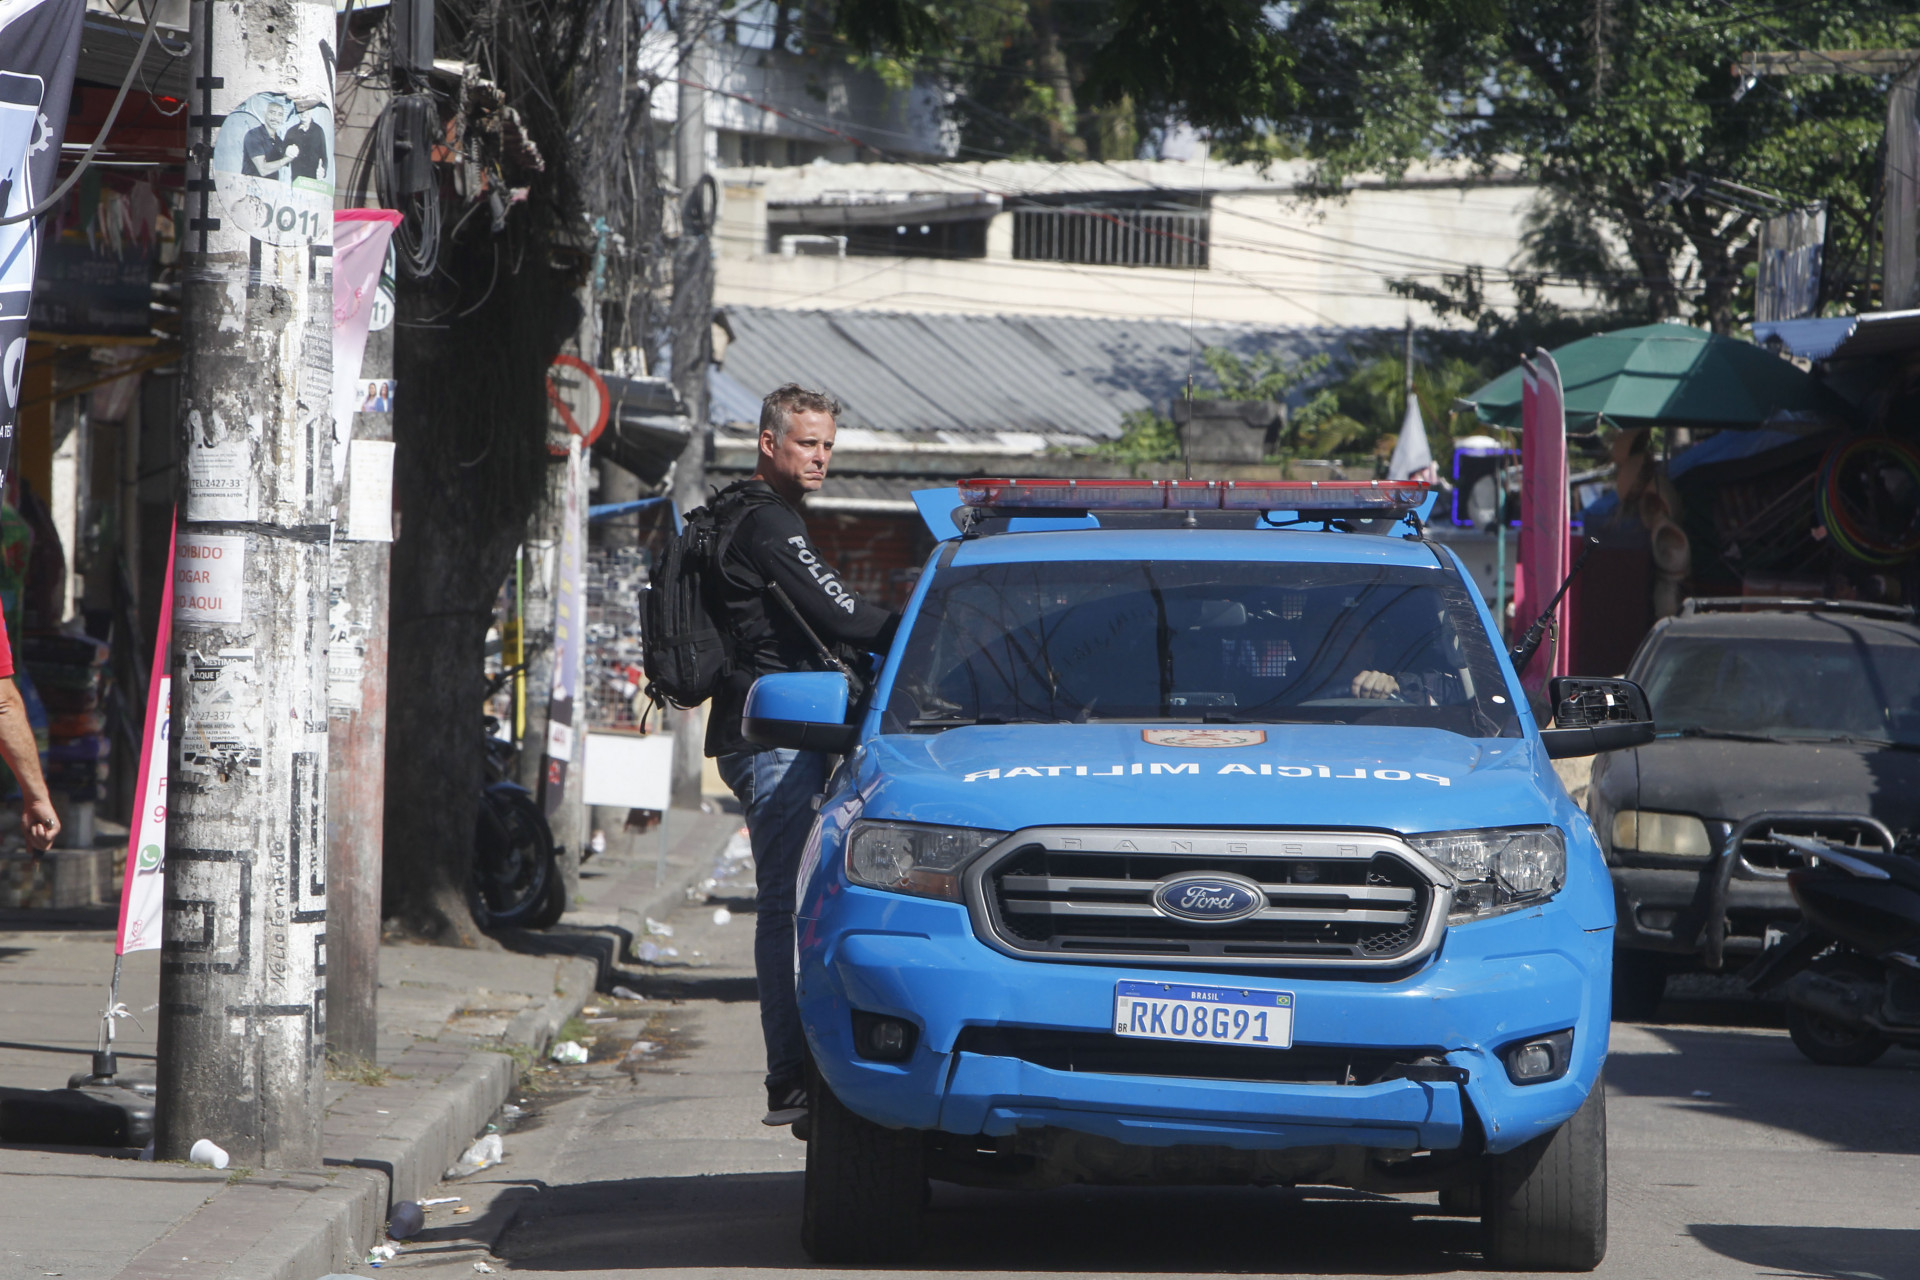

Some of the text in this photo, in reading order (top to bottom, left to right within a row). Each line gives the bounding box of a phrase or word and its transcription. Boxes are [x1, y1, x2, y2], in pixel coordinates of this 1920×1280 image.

[189, 595, 222, 611] AQUI
[1060, 838, 1359, 856] RANGER
[1180, 886, 1236, 910] Ford
[1191, 991, 1219, 1001] BRASIL
[1117, 1022, 1128, 1033] BR
